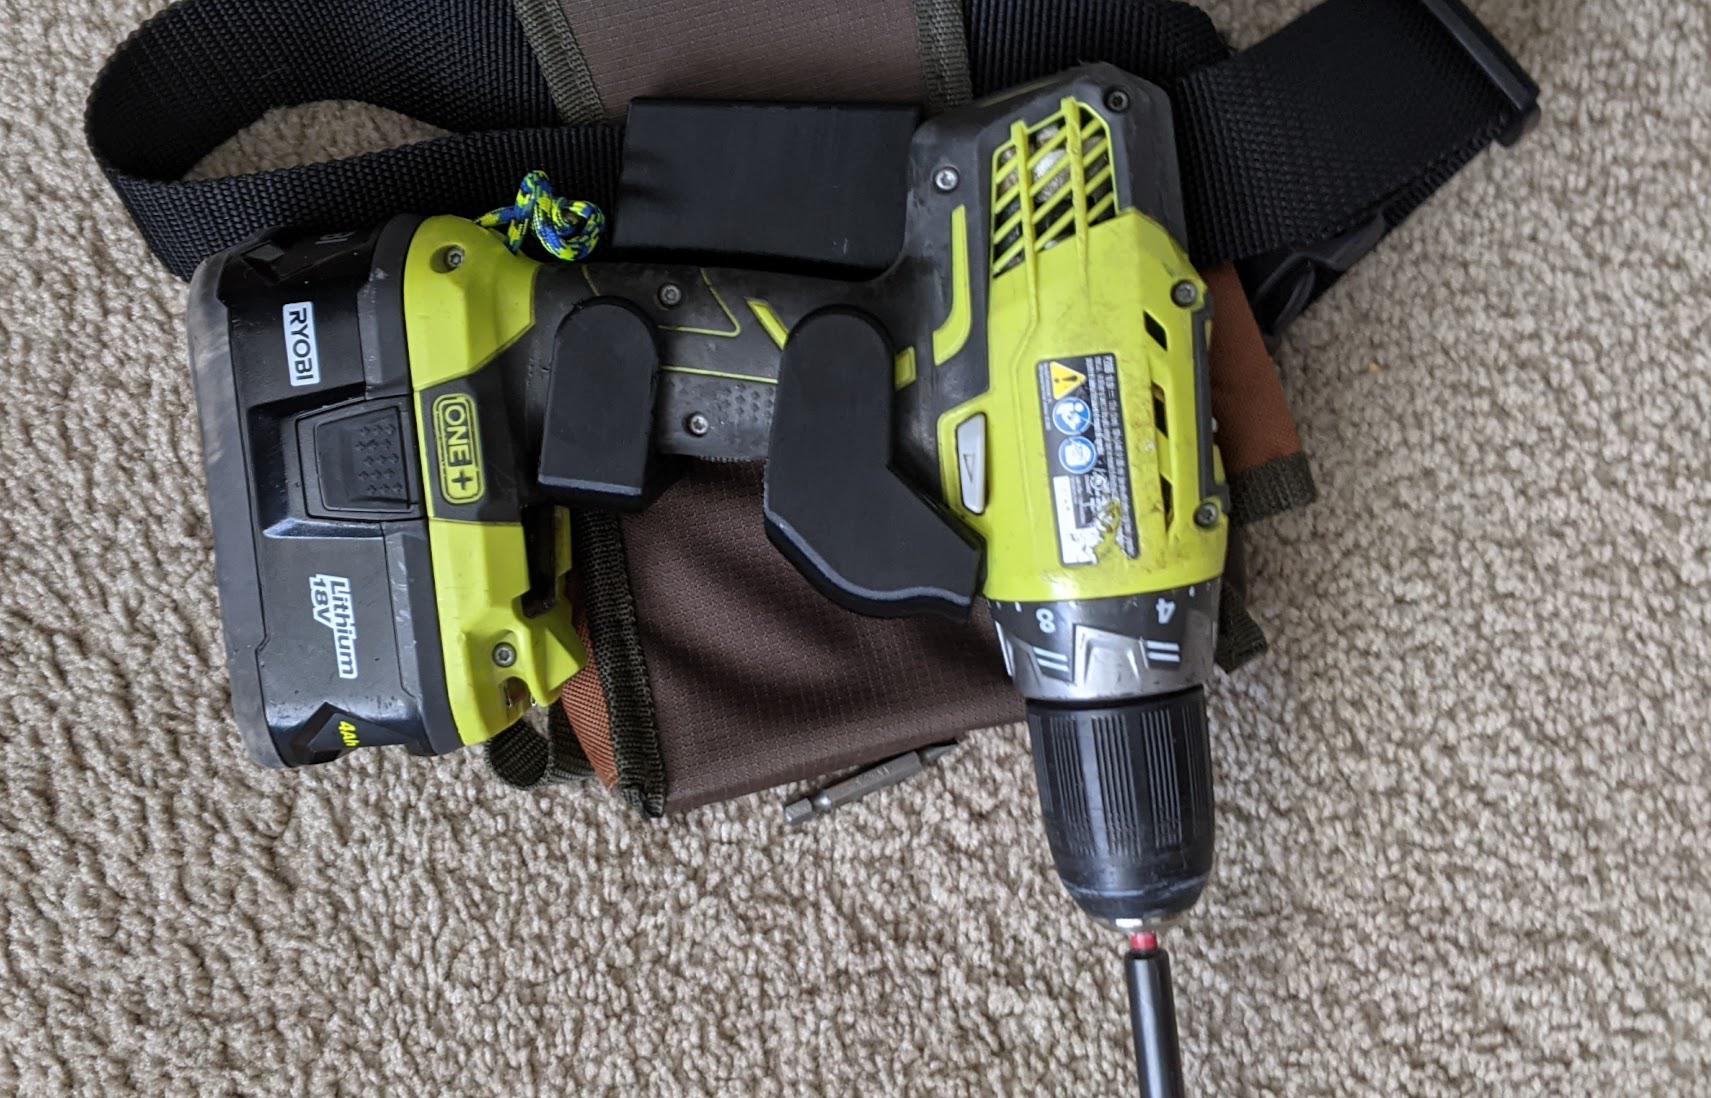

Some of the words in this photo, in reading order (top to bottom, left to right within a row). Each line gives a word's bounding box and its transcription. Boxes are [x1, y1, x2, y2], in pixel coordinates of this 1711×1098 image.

[288, 307, 315, 381] RYOBI
[444, 404, 475, 491] ONE+
[311, 577, 333, 625] 18V
[329, 578, 356, 676] Lithium
[1036, 608, 1056, 633] 8
[1156, 598, 1176, 624] 4
